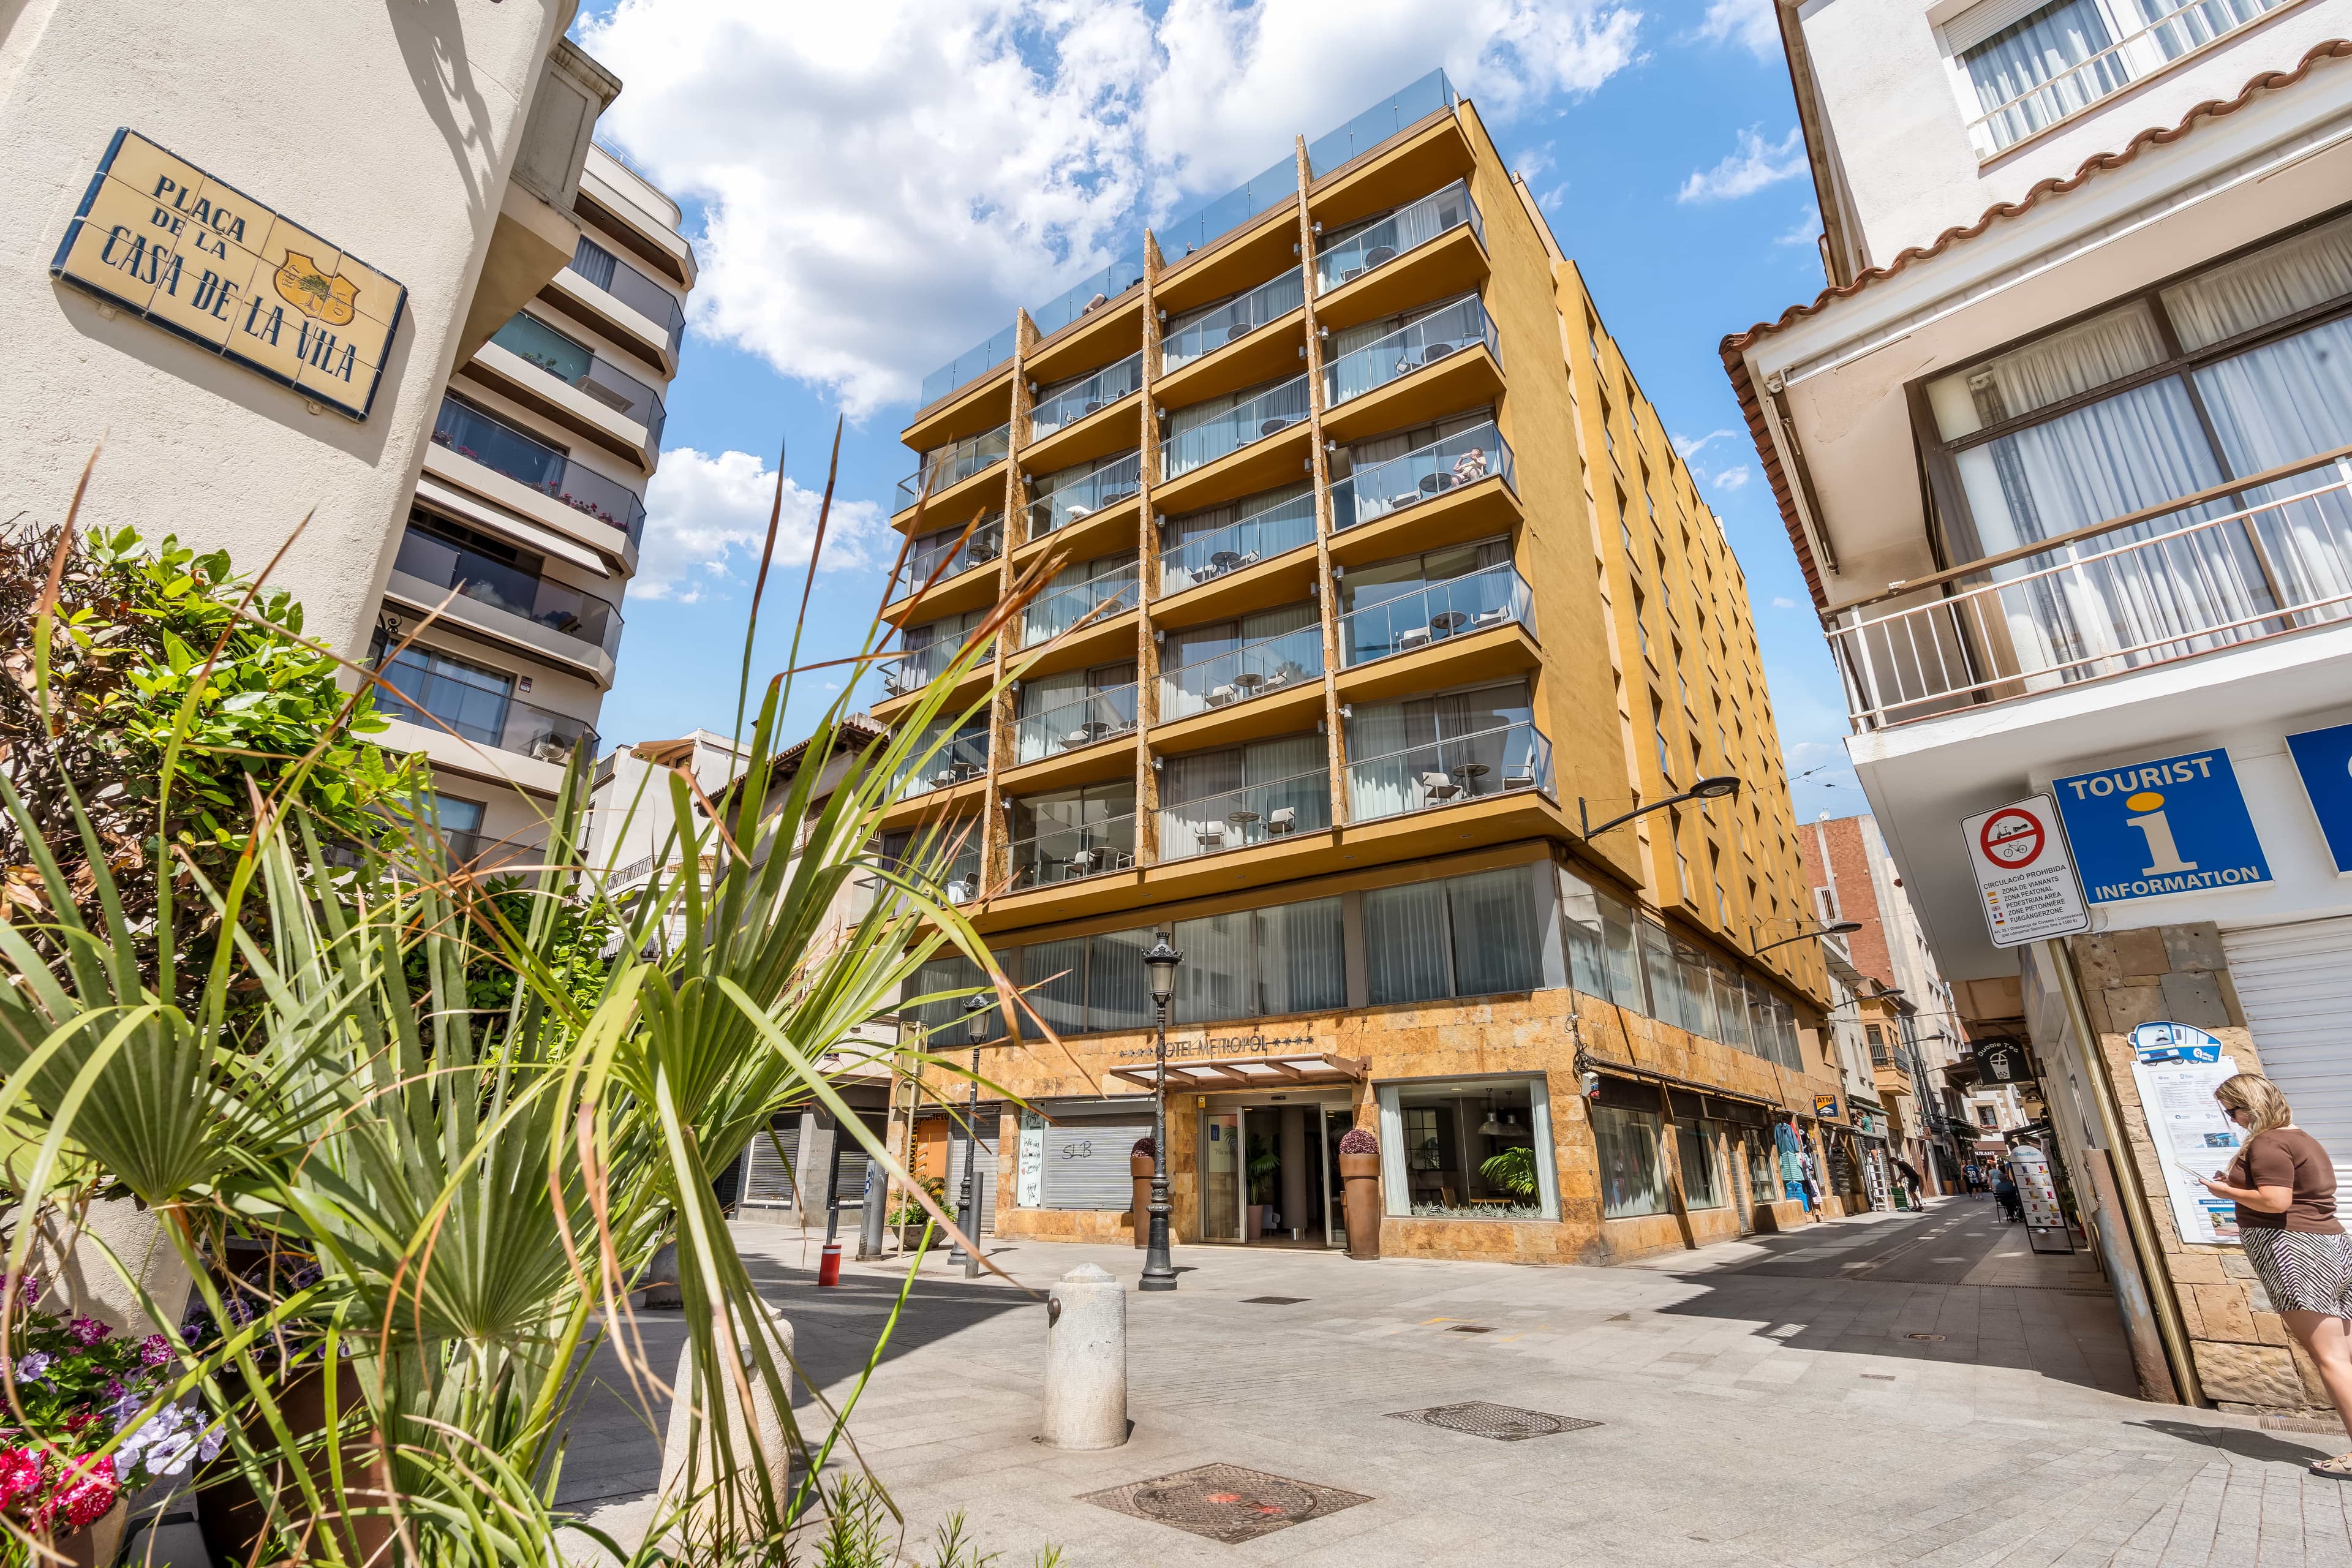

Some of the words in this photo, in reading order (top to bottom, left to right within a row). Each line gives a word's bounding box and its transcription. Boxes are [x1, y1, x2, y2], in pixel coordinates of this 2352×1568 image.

[151, 174, 246, 243] PLAÇA
[149, 206, 187, 237] DE
[194, 230, 226, 261] LA
[100, 224, 185, 298] CASA
[190, 267, 239, 322] DE
[243, 294, 284, 348] LA
[296, 319, 357, 383] VILA
[2068, 756, 2212, 800] TOURIST
[1983, 874, 2025, 889] CIRCULACIÓ
[2026, 864, 2067, 879] PROHIBIDA
[2028, 876, 2059, 888] VIANANTS
[2095, 865, 2260, 900] INFORMATION
[2004, 893, 2021, 902] ZONA
[2021, 886, 2054, 897] PEATONAL
[2006, 897, 2044, 909] PEDESTRIAN
[2045, 891, 2062, 900] AREA
[1157, 1041, 1194, 1058] OTEL
[1197, 1035, 1267, 1056] METROPOL
[1978, 1042, 2002, 1057] Bubble
[2003, 1042, 2019, 1053] Tea
